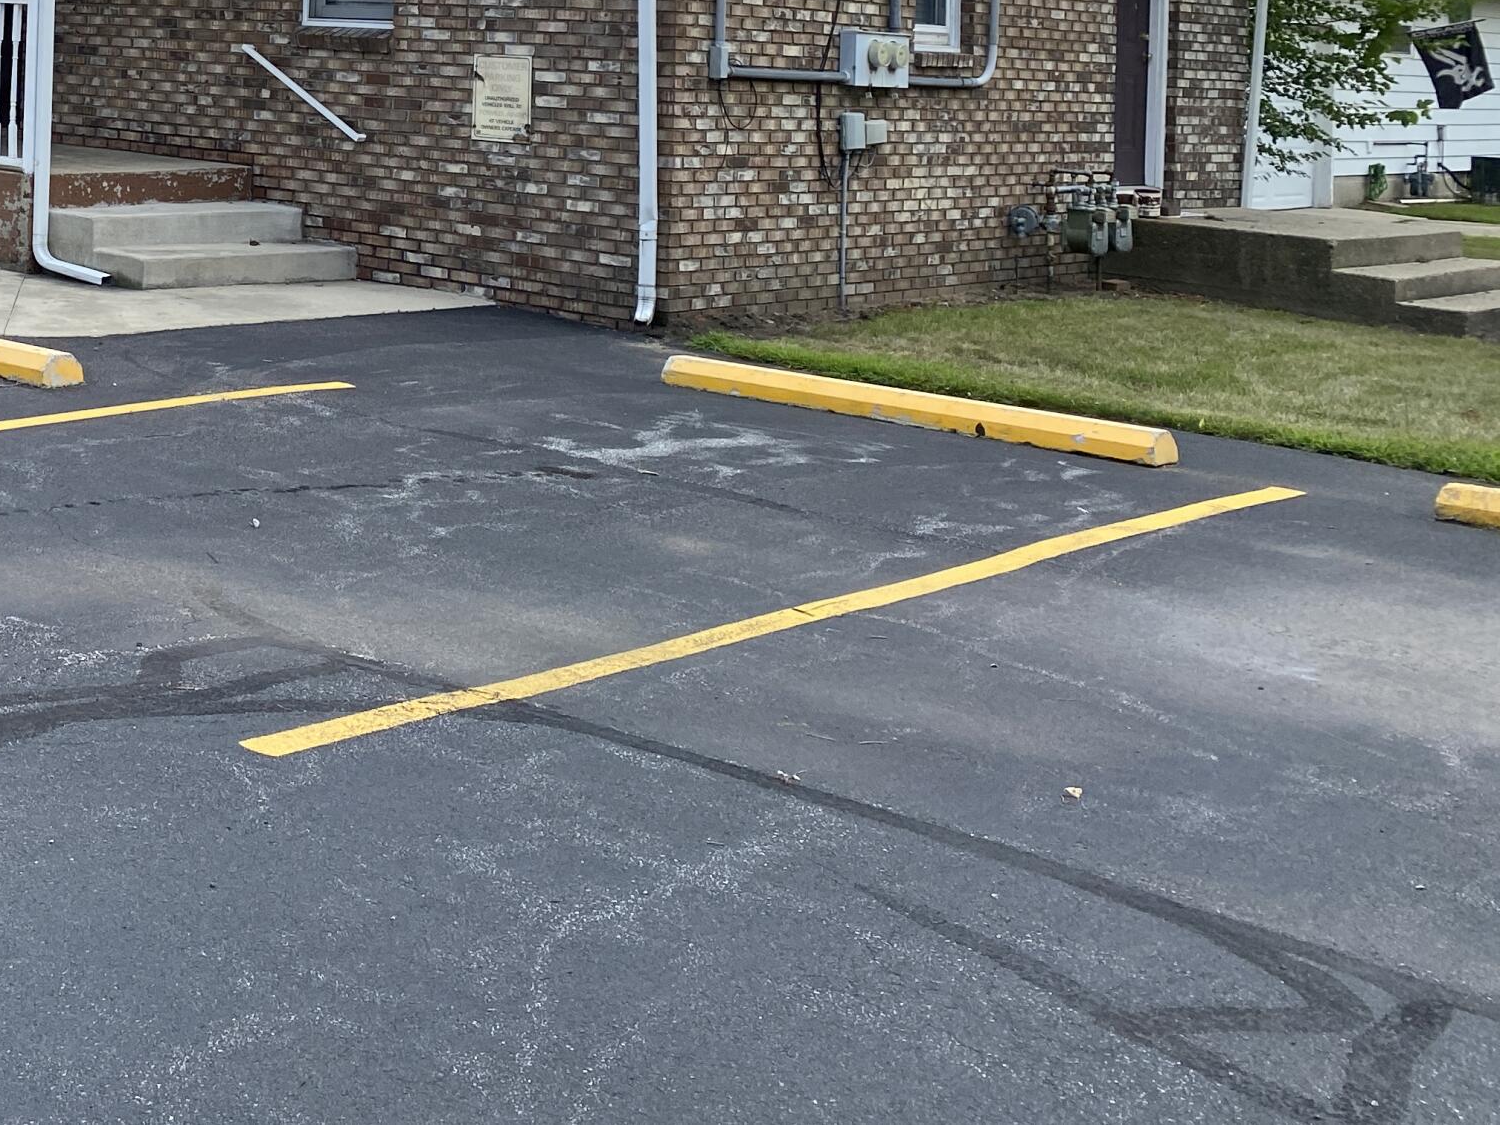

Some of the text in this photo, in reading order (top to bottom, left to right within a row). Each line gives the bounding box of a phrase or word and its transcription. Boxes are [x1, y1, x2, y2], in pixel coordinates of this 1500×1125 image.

[479, 60, 528, 71] CUSTOMER
[484, 72, 521, 83] PARKING
[484, 95, 520, 103] UNAUTHORIZED
